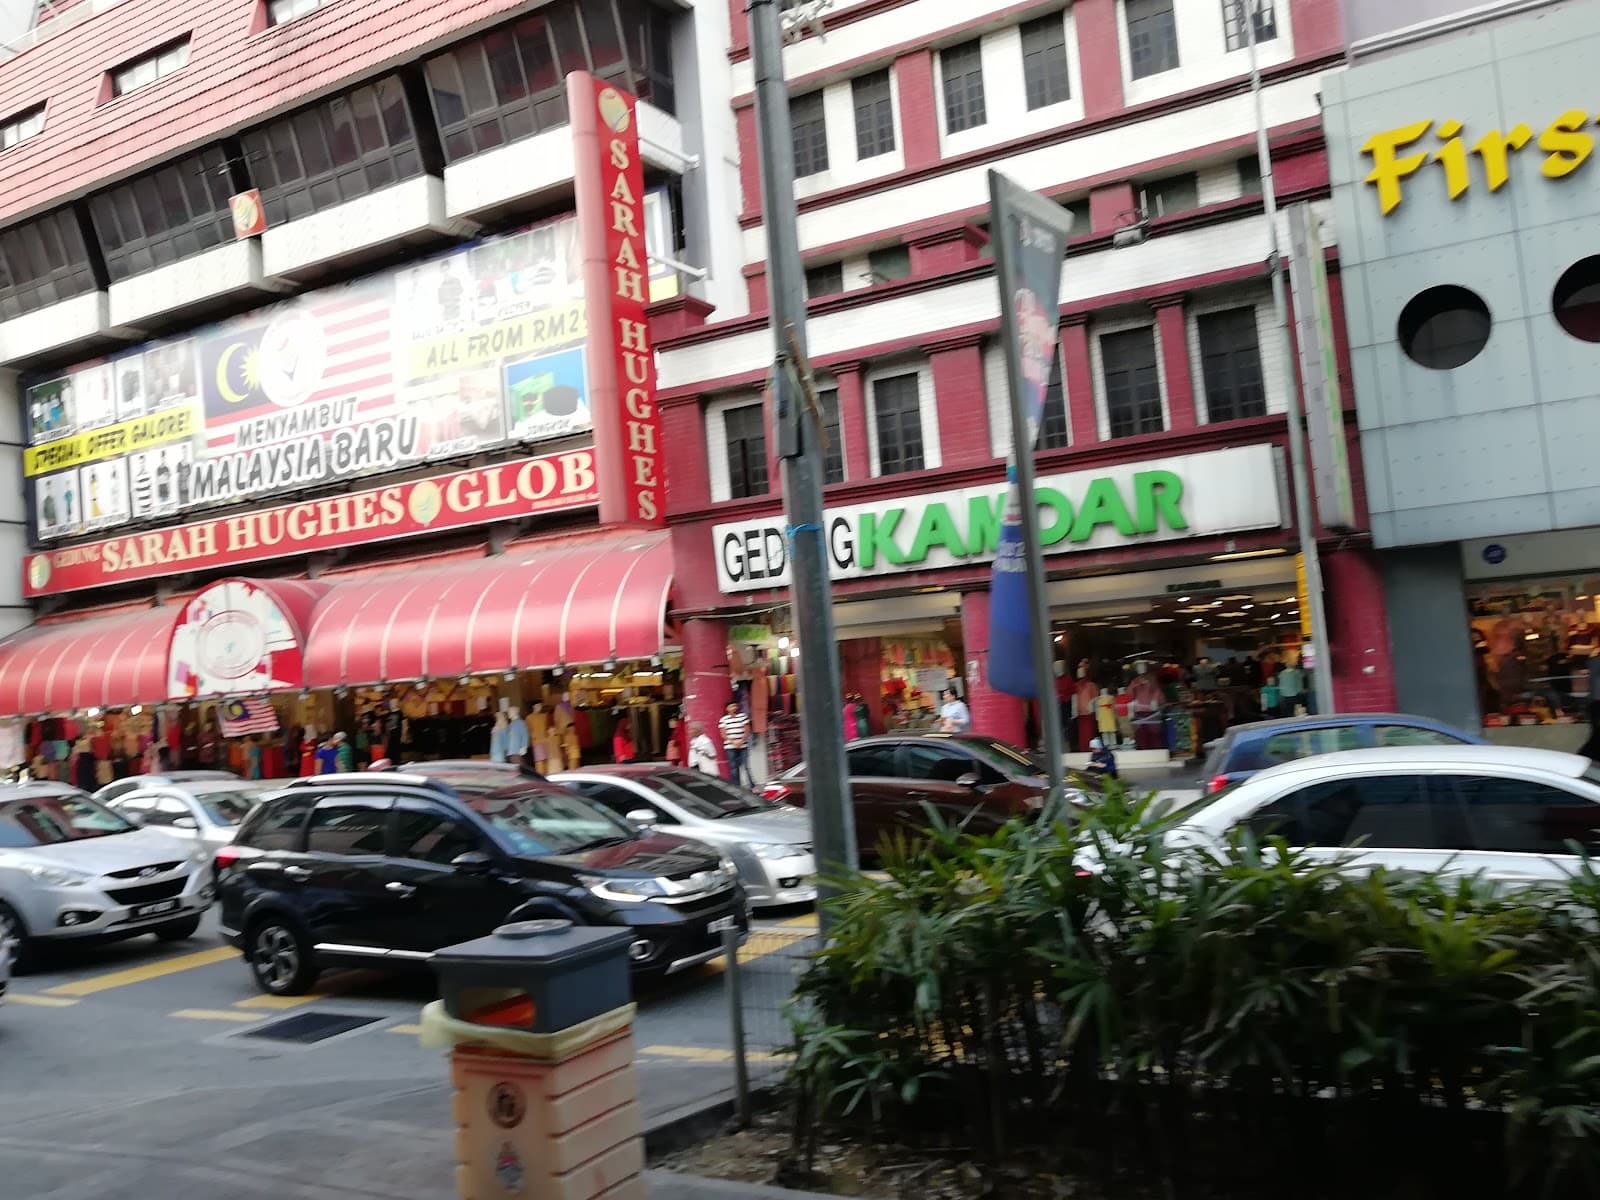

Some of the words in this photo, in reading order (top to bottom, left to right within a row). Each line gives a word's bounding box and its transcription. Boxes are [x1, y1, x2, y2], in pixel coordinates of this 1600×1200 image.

[1361, 109, 1600, 217] Firs
[610, 138, 645, 304] SARAH
[425, 343, 459, 369] ALL
[467, 324, 523, 358] FROM
[34, 440, 82, 471] SPECIAL
[88, 429, 126, 456] OFFER
[193, 438, 321, 499] MALAYSIA
[334, 415, 418, 471] BARU
[236, 397, 358, 448] MENYAMBUT
[618, 317, 658, 521] HUGHES
[102, 519, 218, 573] SARAH
[226, 486, 404, 553] HUGHES
[723, 516, 856, 583] GEDG
